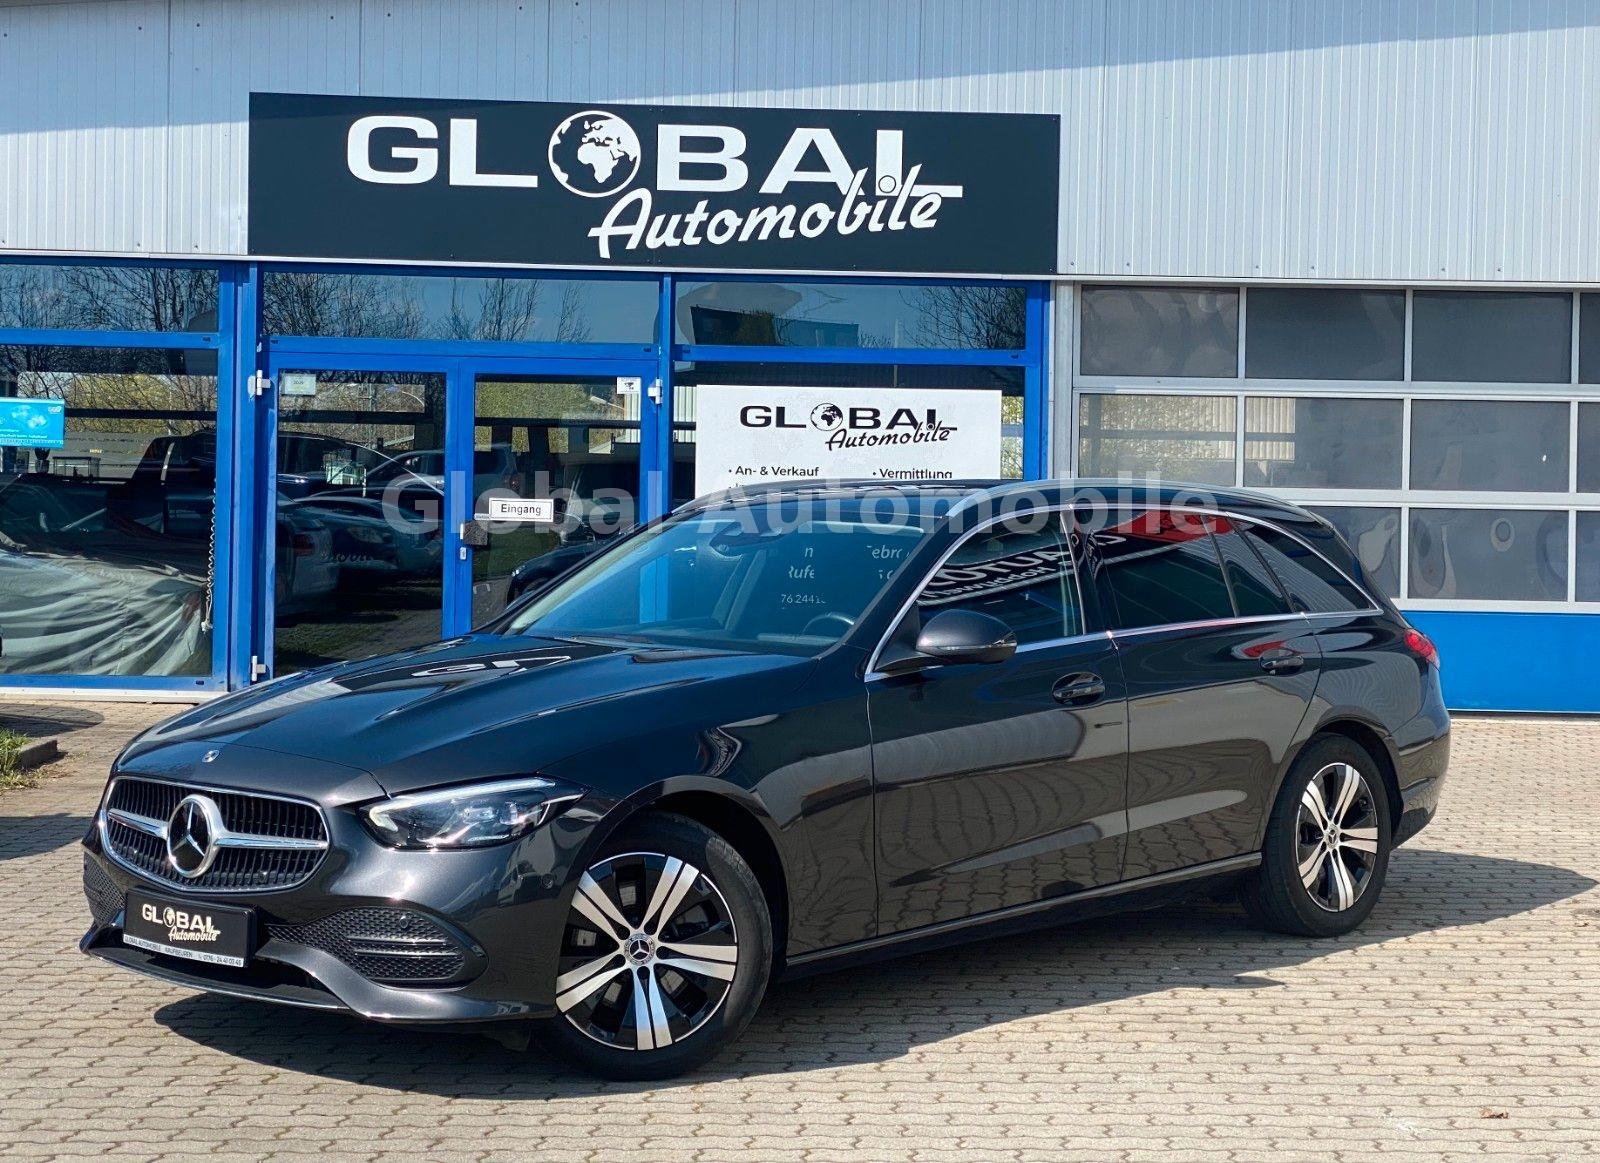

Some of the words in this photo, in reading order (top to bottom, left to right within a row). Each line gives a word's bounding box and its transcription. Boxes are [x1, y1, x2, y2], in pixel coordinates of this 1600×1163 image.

[347, 110, 963, 198] GLOBAL
[587, 163, 942, 259] Automobile
[740, 403, 957, 431] GLOBAL
[825, 420, 951, 450] Automobile
[735, 466, 756, 476] An-
[759, 466, 769, 477] &
[771, 466, 819, 477] Verkauf
[879, 468, 953, 479] Vermittlung
[501, 503, 541, 516] Eingang
[142, 904, 221, 935] GLOBAL
[168, 925, 218, 941] Automobile
